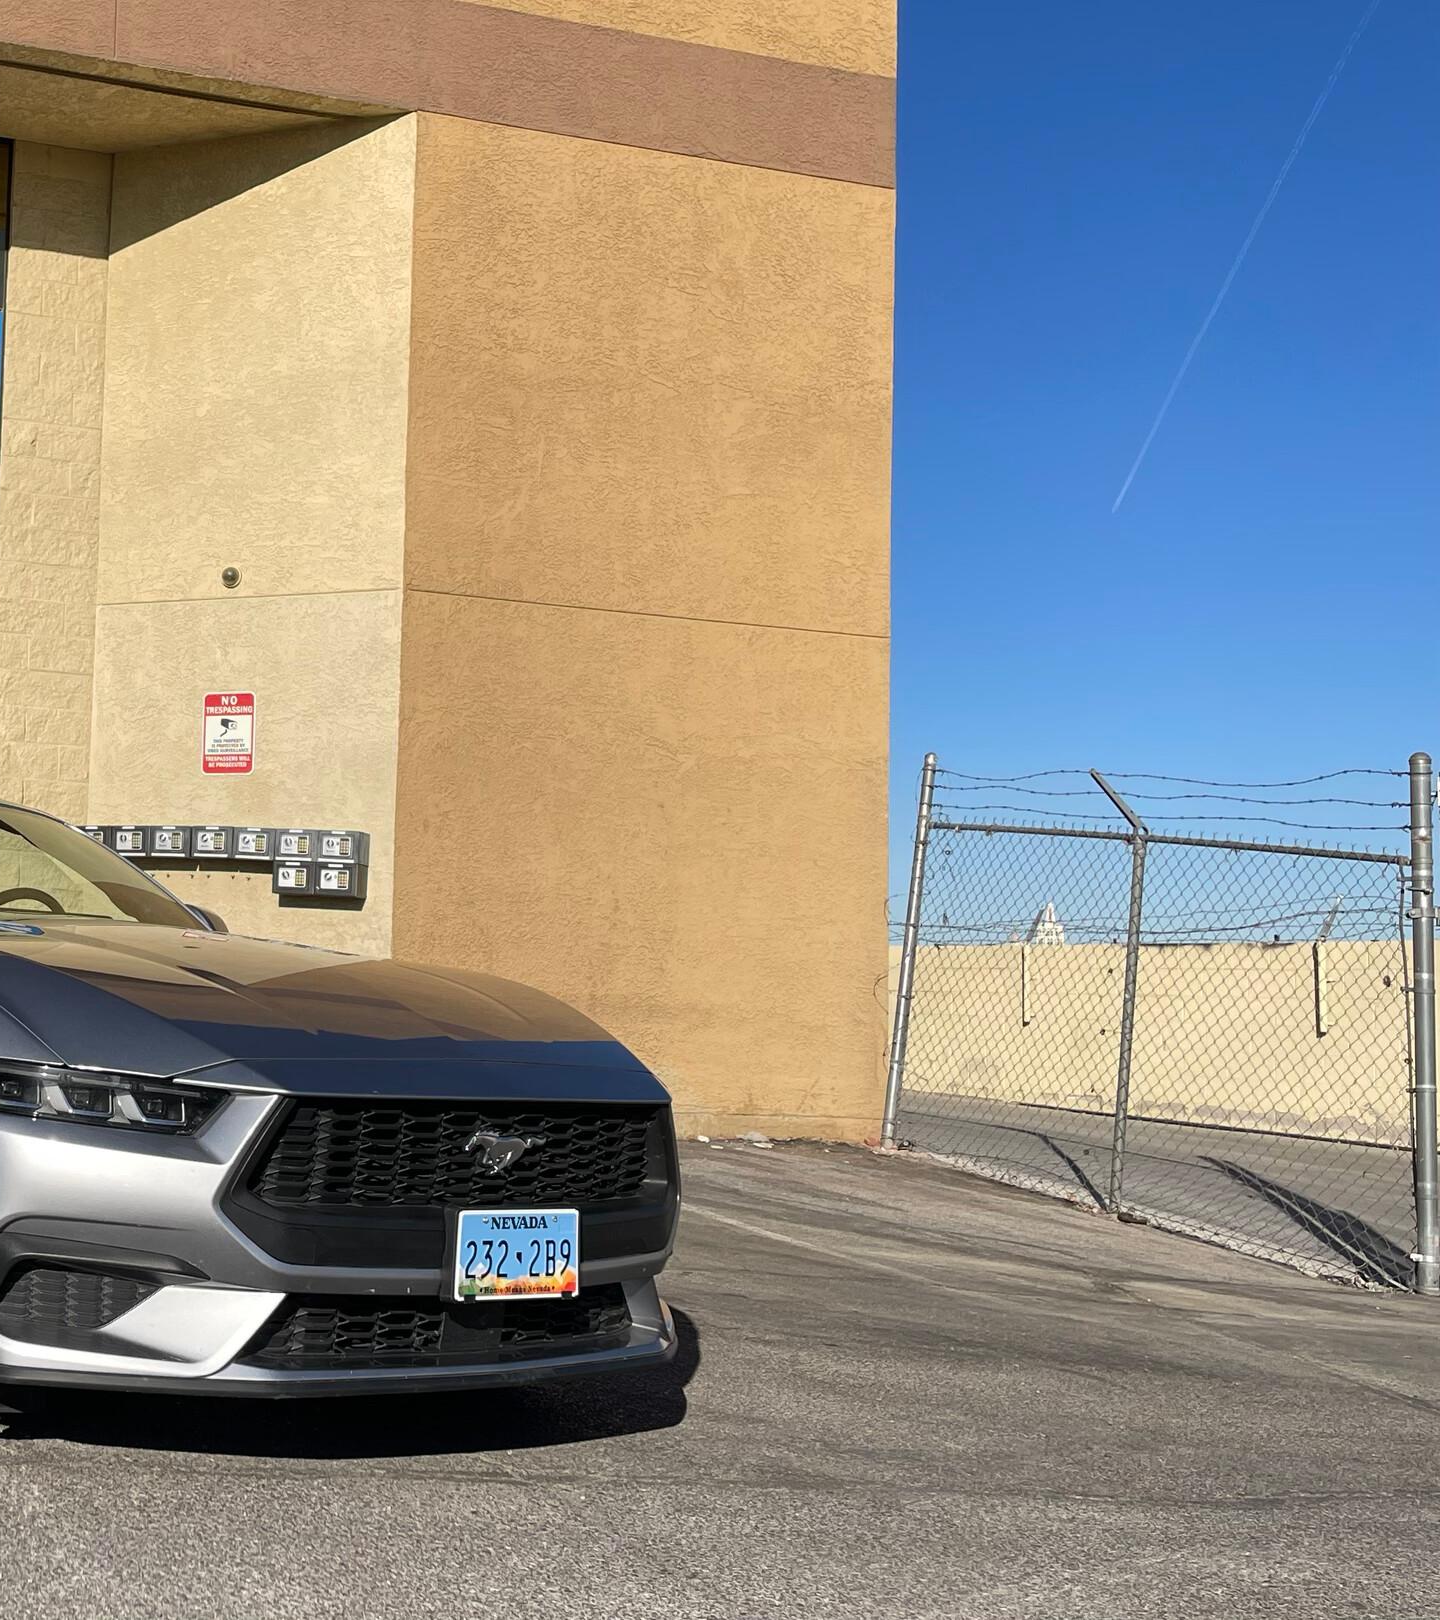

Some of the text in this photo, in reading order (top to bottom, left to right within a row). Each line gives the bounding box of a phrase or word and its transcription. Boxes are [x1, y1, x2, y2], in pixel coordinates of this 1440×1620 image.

[221, 695, 238, 706] NO
[206, 705, 253, 714] TRESPASSING
[490, 1215, 549, 1230] NEVADA
[464, 1239, 572, 1280] 232 2B9
